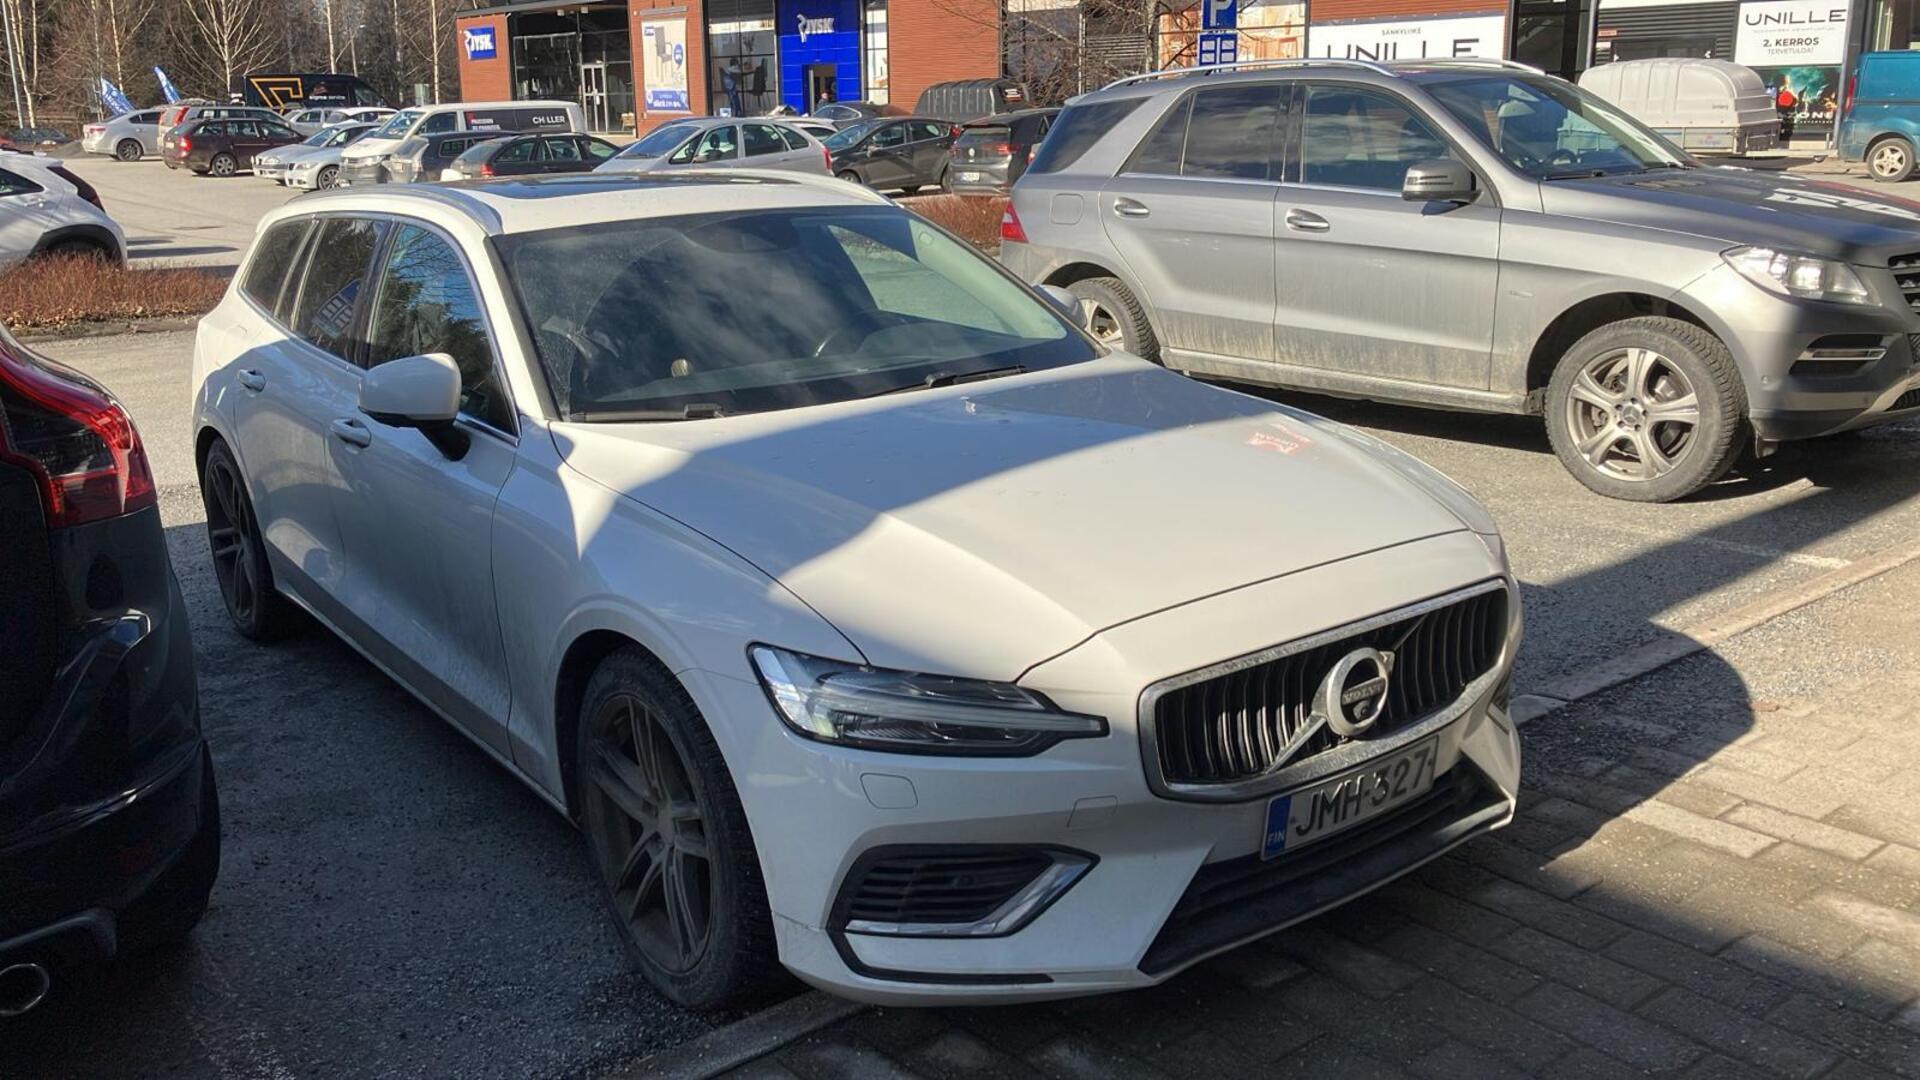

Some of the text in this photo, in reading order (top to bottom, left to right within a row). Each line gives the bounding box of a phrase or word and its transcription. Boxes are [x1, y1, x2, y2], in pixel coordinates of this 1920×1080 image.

[1210, 0, 1234, 26] P
[1745, 9, 1847, 26] UNILLE
[805, 17, 834, 34] JYSK
[470, 34, 494, 52] JYSK
[1763, 37, 1820, 48] 2. KERROS
[1296, 750, 1428, 836] JMH-327
